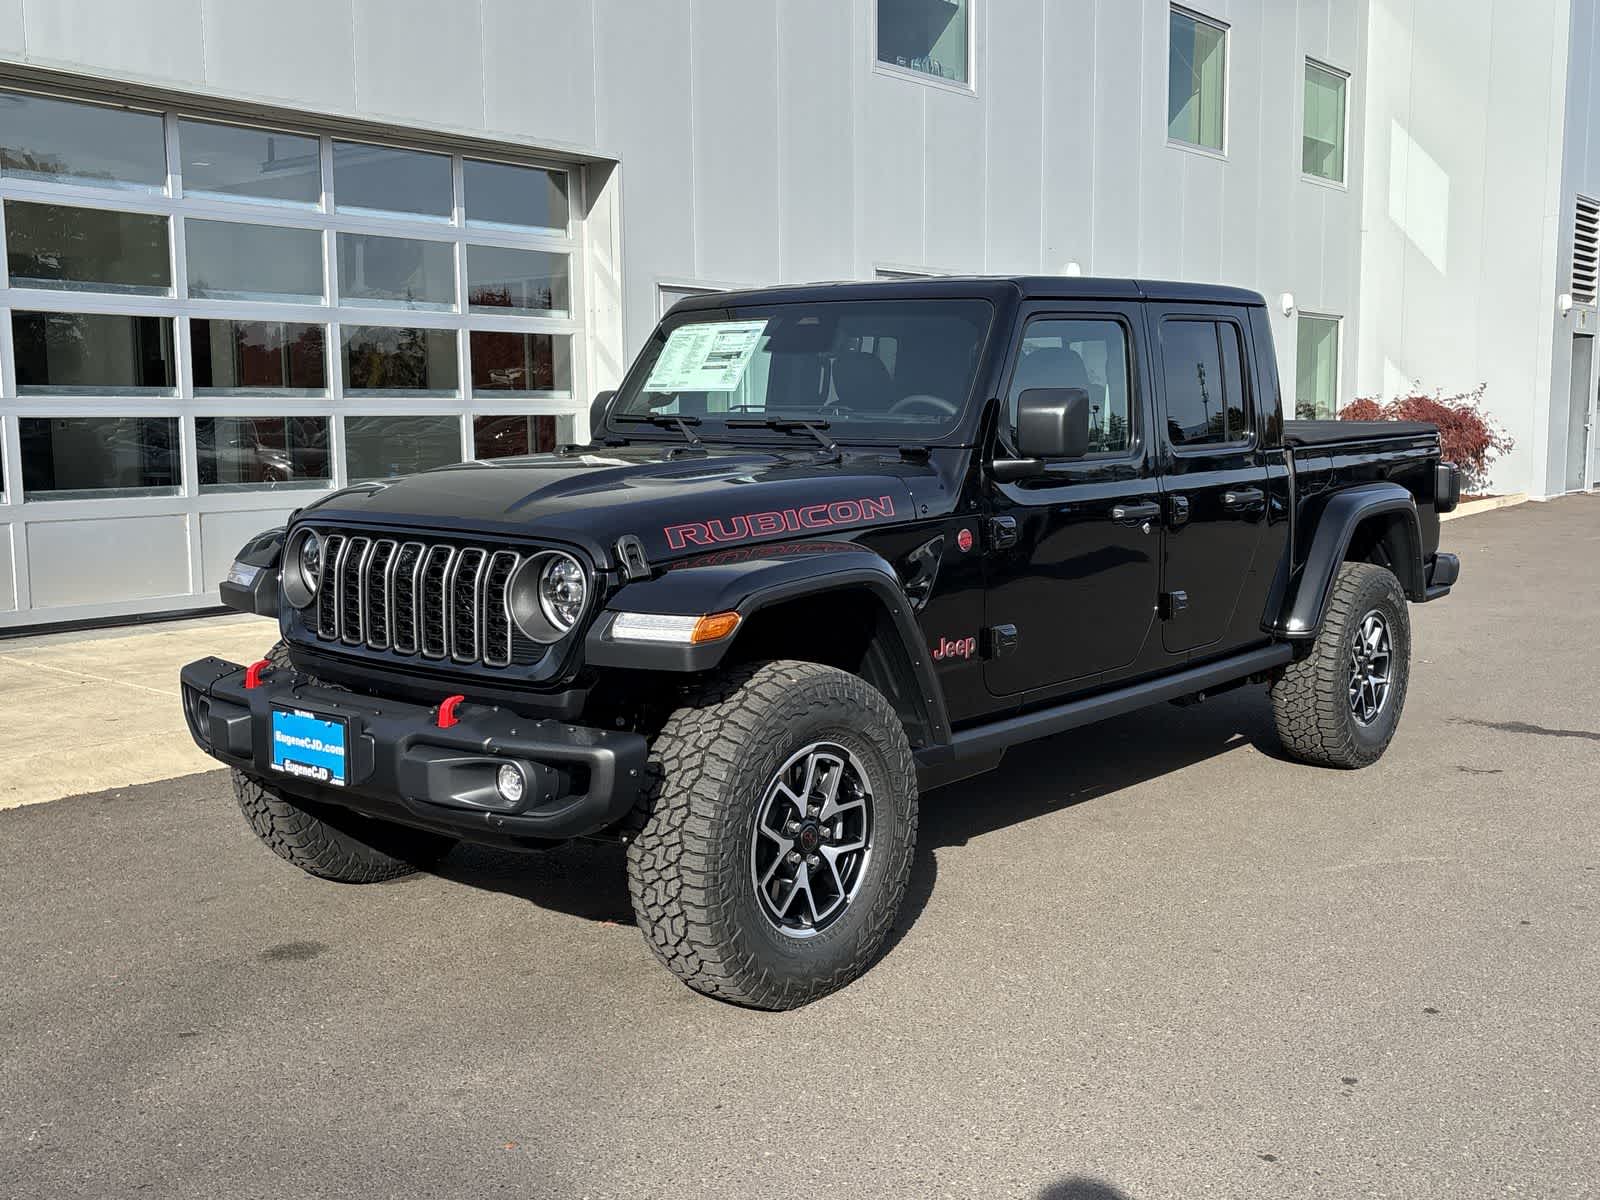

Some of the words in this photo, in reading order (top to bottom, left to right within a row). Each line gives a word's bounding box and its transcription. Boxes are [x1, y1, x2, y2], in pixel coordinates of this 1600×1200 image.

[663, 495, 896, 551] RUBICON
[932, 635, 977, 662] Jeep
[275, 730, 345, 756] EugeneCJD.com
[284, 759, 328, 781] EugeneCJD
